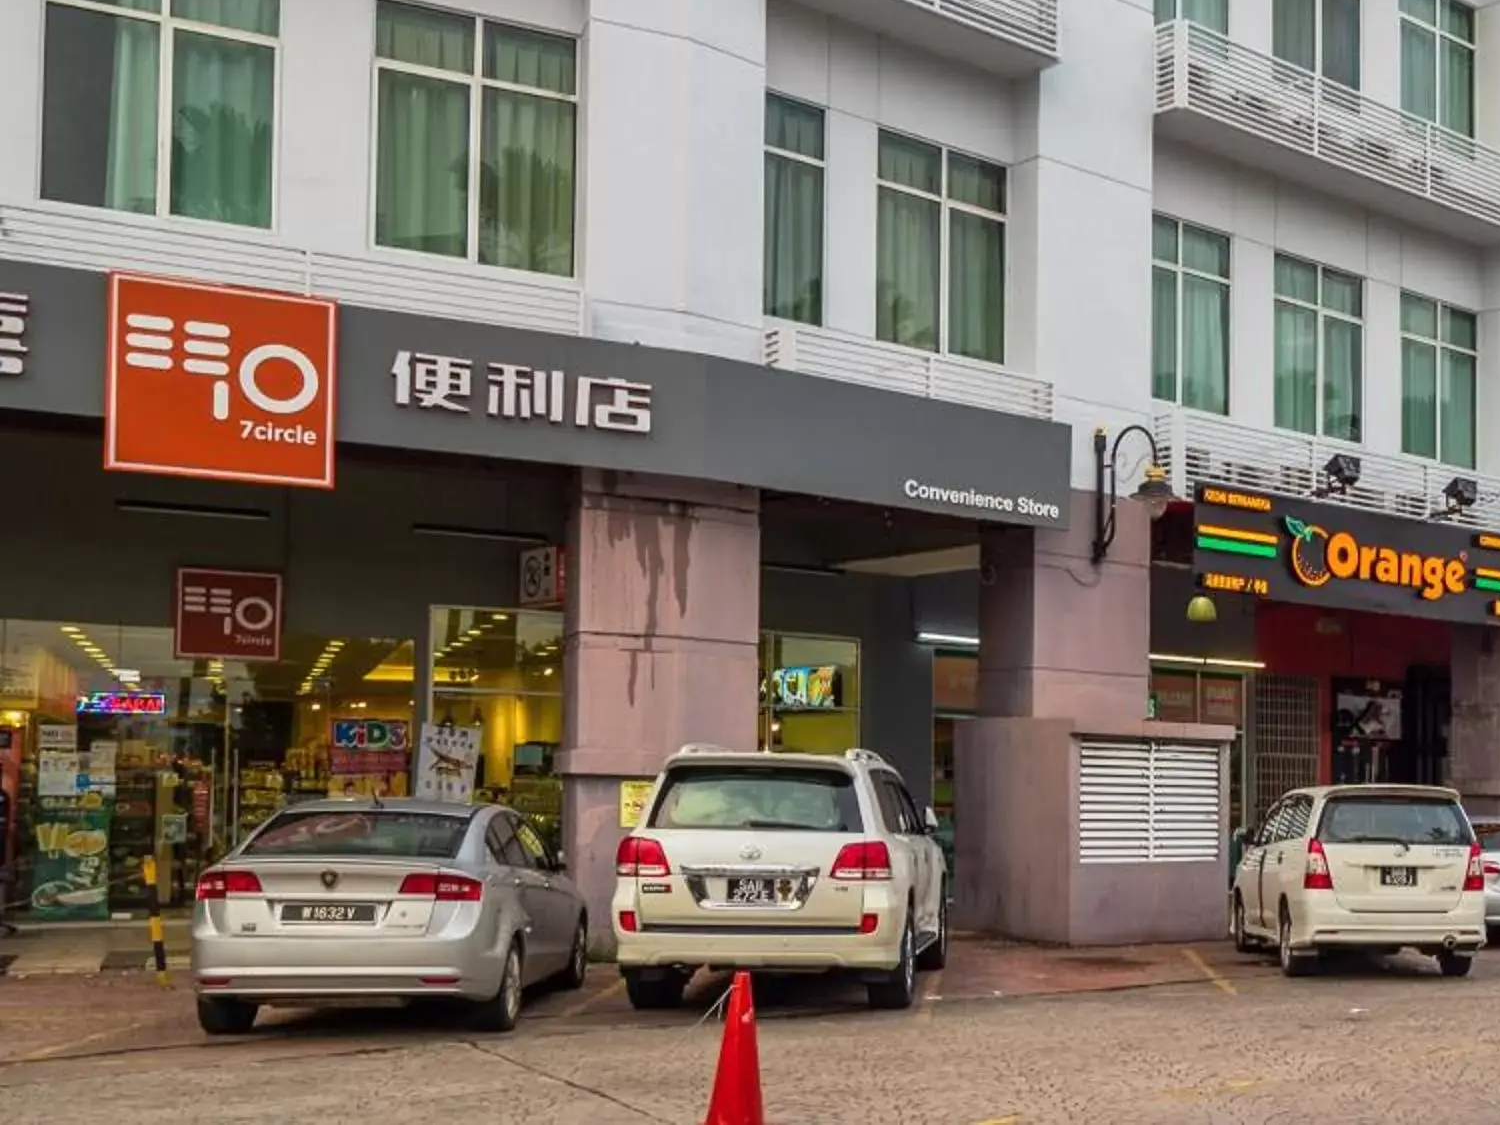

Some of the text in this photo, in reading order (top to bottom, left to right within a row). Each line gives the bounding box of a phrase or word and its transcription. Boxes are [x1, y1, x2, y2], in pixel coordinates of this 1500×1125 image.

[391, 350, 652, 433] 便利店
[240, 420, 317, 446] 7circle
[904, 479, 1060, 519] Convenience Store
[1327, 531, 1466, 600] Orange
